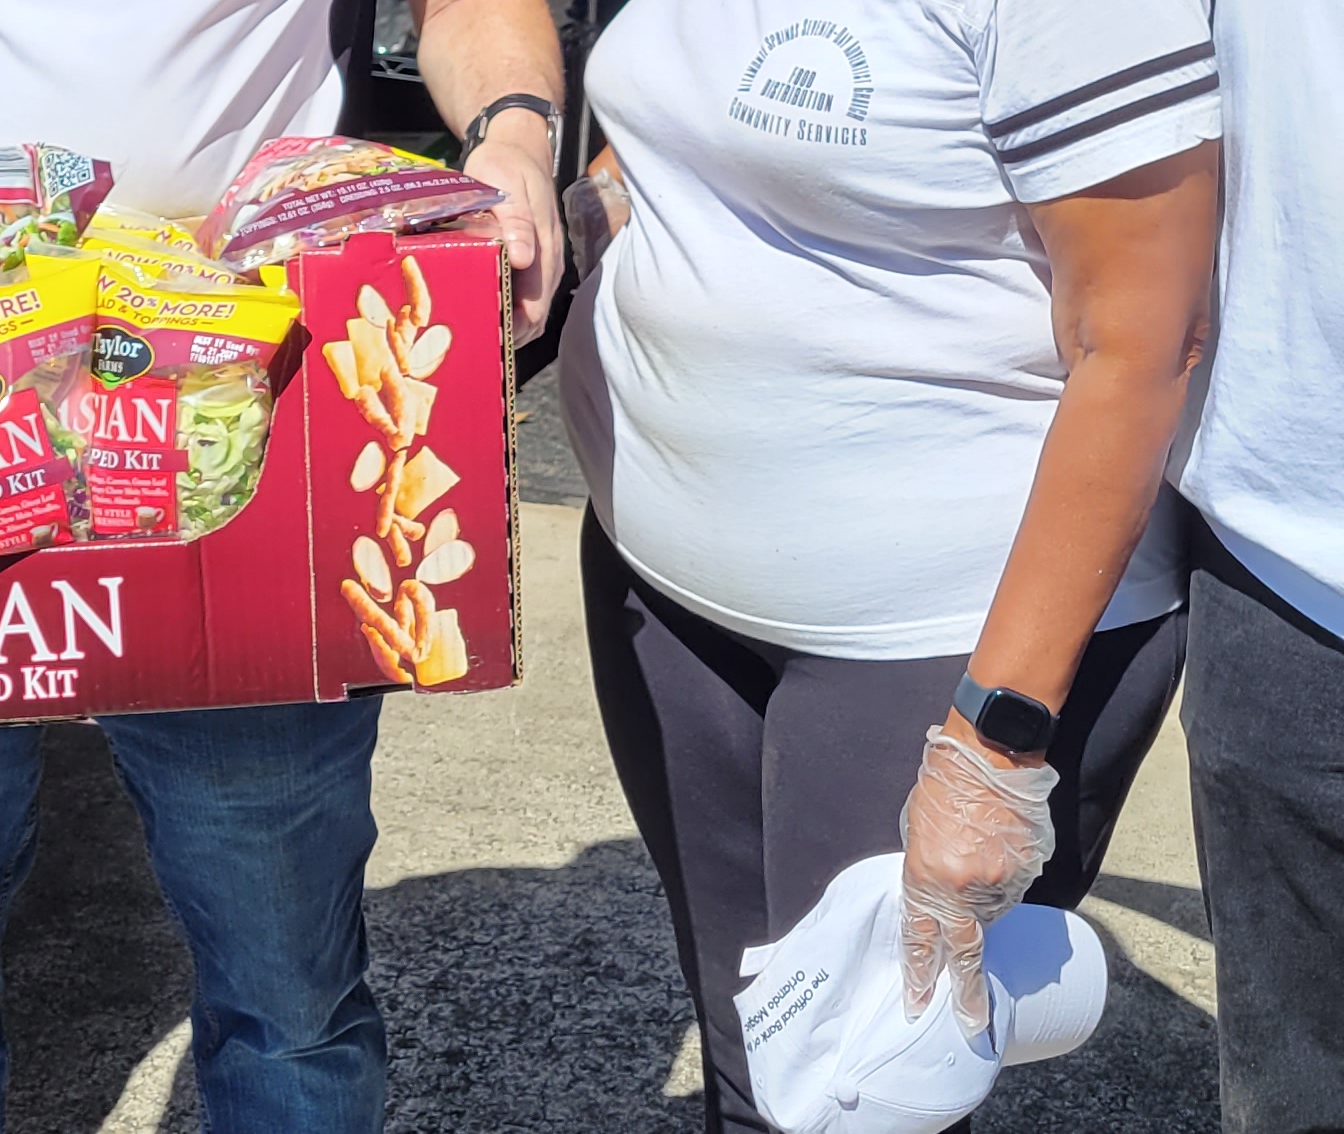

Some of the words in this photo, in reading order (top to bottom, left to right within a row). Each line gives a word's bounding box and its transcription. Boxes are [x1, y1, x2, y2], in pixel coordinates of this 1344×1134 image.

[788, 66, 817, 89] FOOD
[760, 78, 834, 113] DISTRIBUTION
[729, 97, 791, 137] COMMUNITY
[797, 119, 867, 146] SERVICES
[199, 268, 243, 285] MO
[116, 287, 158, 308] 20%
[158, 300, 236, 318] MORE!
[133, 312, 198, 326] TOPPINGS
[124, 450, 162, 470] KIT
[7, 469, 46, 496] KIT
[21, 665, 78, 700] KIT
[767, 970, 806, 1009] Orlando
[811, 968, 829, 989] The
[781, 989, 813, 1026] Official
[760, 1020, 783, 1043] Bank
